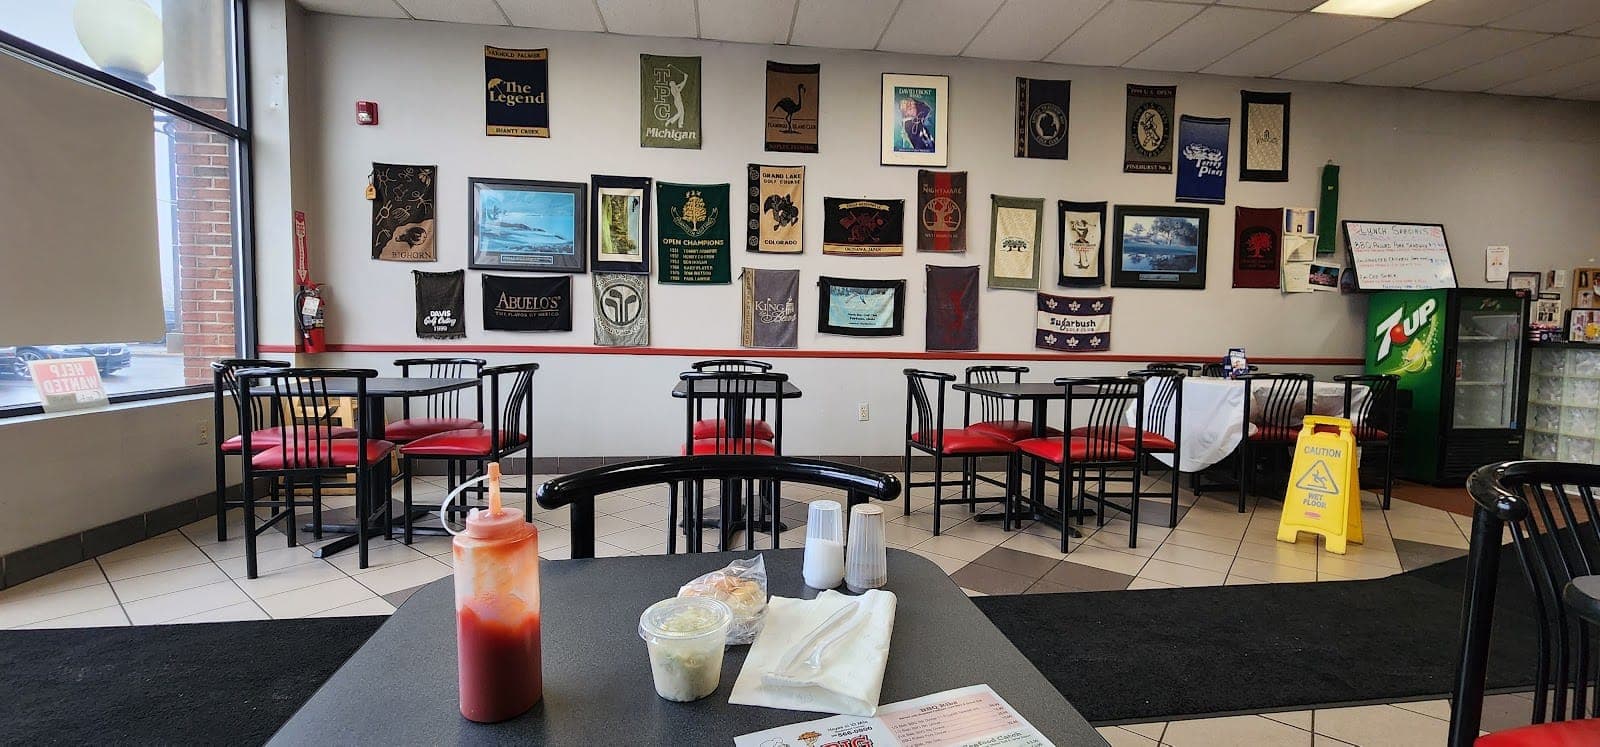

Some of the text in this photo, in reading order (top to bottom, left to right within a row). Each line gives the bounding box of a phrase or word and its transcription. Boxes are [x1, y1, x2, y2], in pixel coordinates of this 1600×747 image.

[506, 81, 531, 93] The
[489, 91, 545, 106] Legend
[653, 68, 671, 121] TPC
[646, 128, 697, 140] Michigan
[1198, 167, 1223, 177] Pines
[1359, 225, 1388, 235] LUNCH
[663, 238, 682, 246] OPEN
[496, 291, 562, 310] ABUELO'S
[1050, 318, 1097, 331] Sugarbush
[1304, 446, 1342, 458] CAUTION
[1308, 492, 1323, 501] WET
[1302, 499, 1327, 508] FLOOR
[920, 704, 939, 713] BBQ
[997, 731, 1023, 742] Catch
